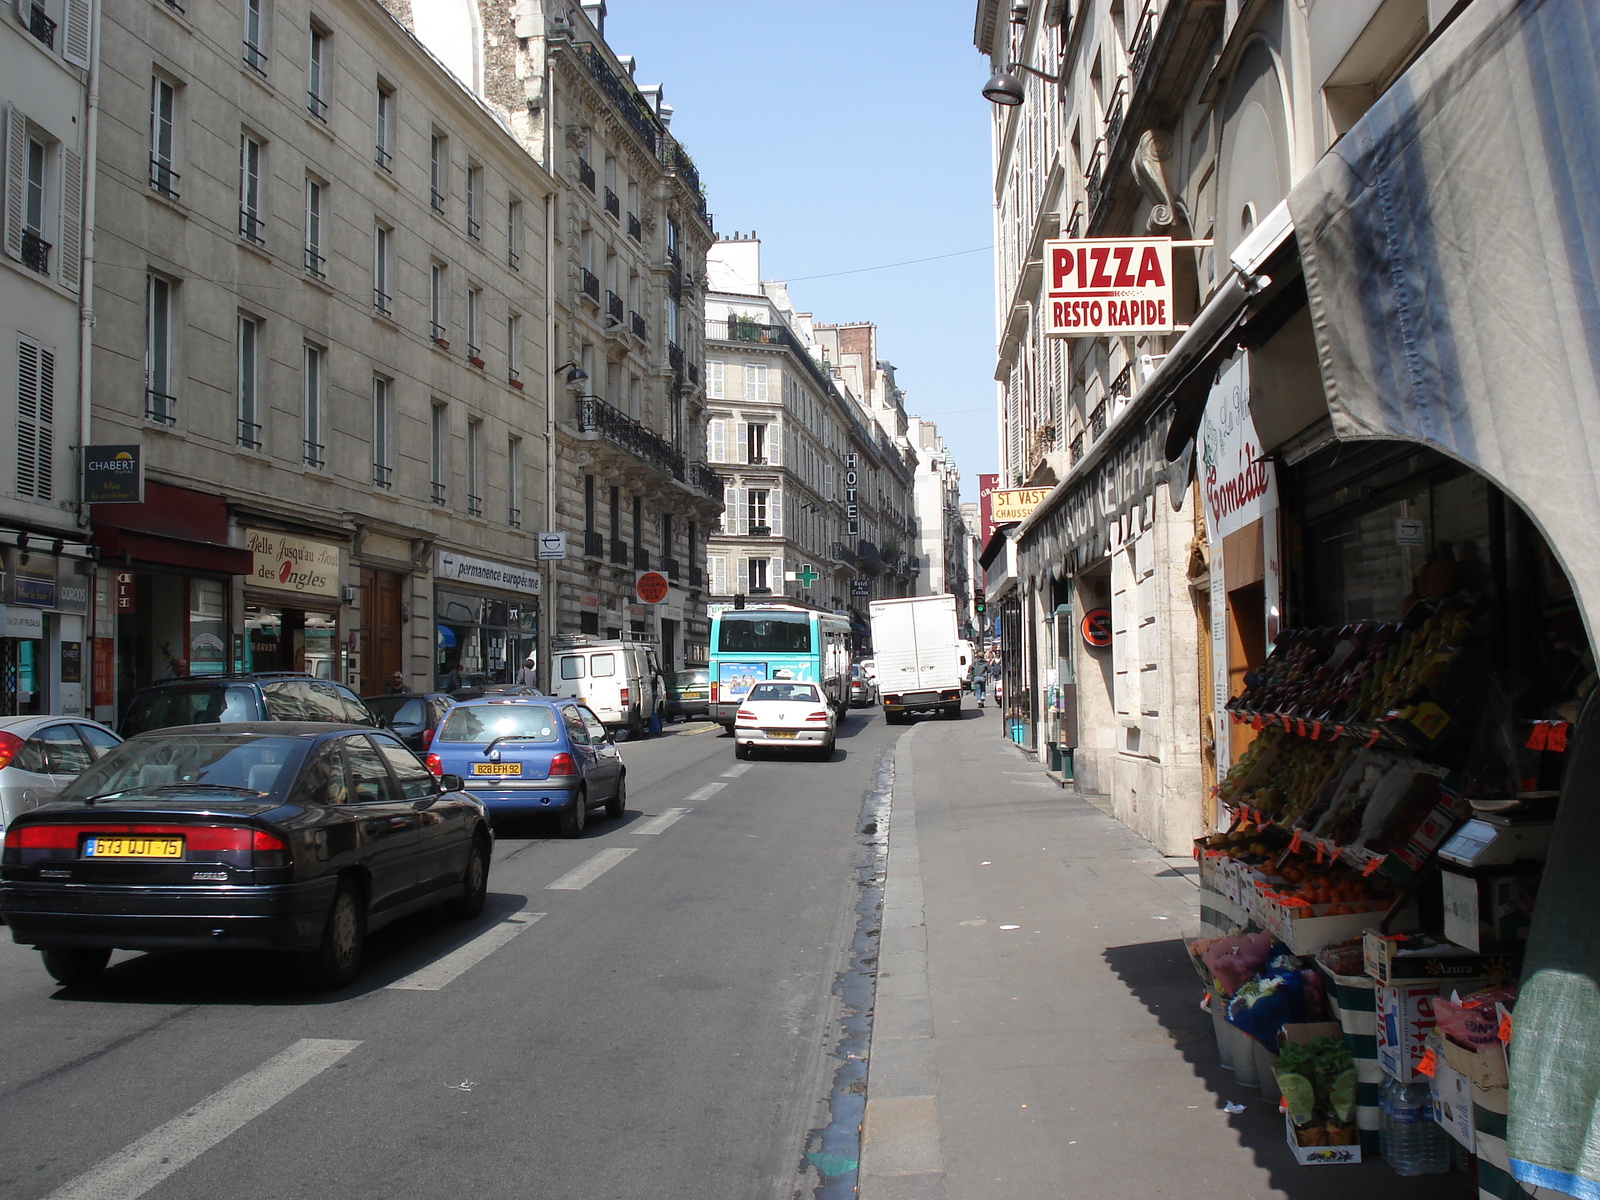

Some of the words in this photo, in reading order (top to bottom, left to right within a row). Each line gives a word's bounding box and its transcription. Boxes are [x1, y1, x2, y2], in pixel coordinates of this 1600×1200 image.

[1052, 246, 1166, 289] PIZZA
[1053, 300, 1103, 328] RESTO
[1107, 299, 1166, 327] RAPIDE
[88, 460, 136, 471] CHABERT
[846, 454, 858, 535] HOTEL
[1206, 441, 1270, 535] Comédie
[997, 492, 1012, 506] ST.
[1018, 490, 1046, 505] VAST
[247, 532, 273, 555] Belle
[276, 538, 314, 565] Jusqu'au
[317, 547, 338, 567] Bout
[258, 564, 275, 580] des
[457, 562, 502, 582] permanence
[502, 572, 539, 590] européenne
[61, 586, 86, 602] CORCOS
[478, 765, 492, 774] 828
[493, 765, 508, 774] EFH
[509, 765, 519, 774] 92
[96, 837, 122, 855] 673
[161, 838, 177, 855] 75
[1435, 962, 1473, 975] Azura
